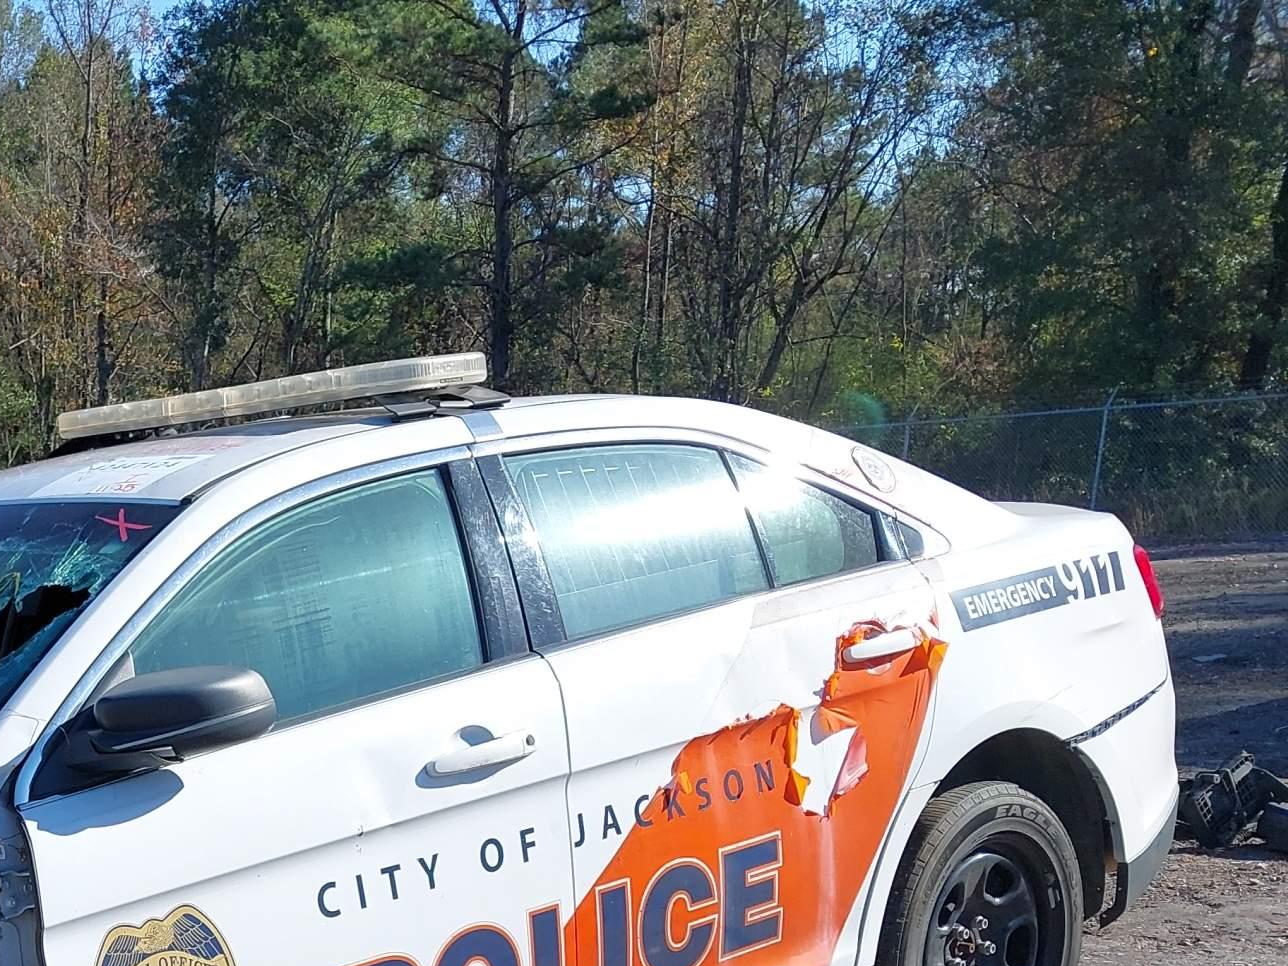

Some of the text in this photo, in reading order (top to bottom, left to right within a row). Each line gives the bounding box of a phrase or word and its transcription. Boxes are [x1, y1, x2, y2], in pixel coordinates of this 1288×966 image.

[963, 551, 1125, 619] EMERGENCY 911
[317, 760, 776, 918] CITY OF JACKSON
[995, 805, 1059, 839] EAGLE
